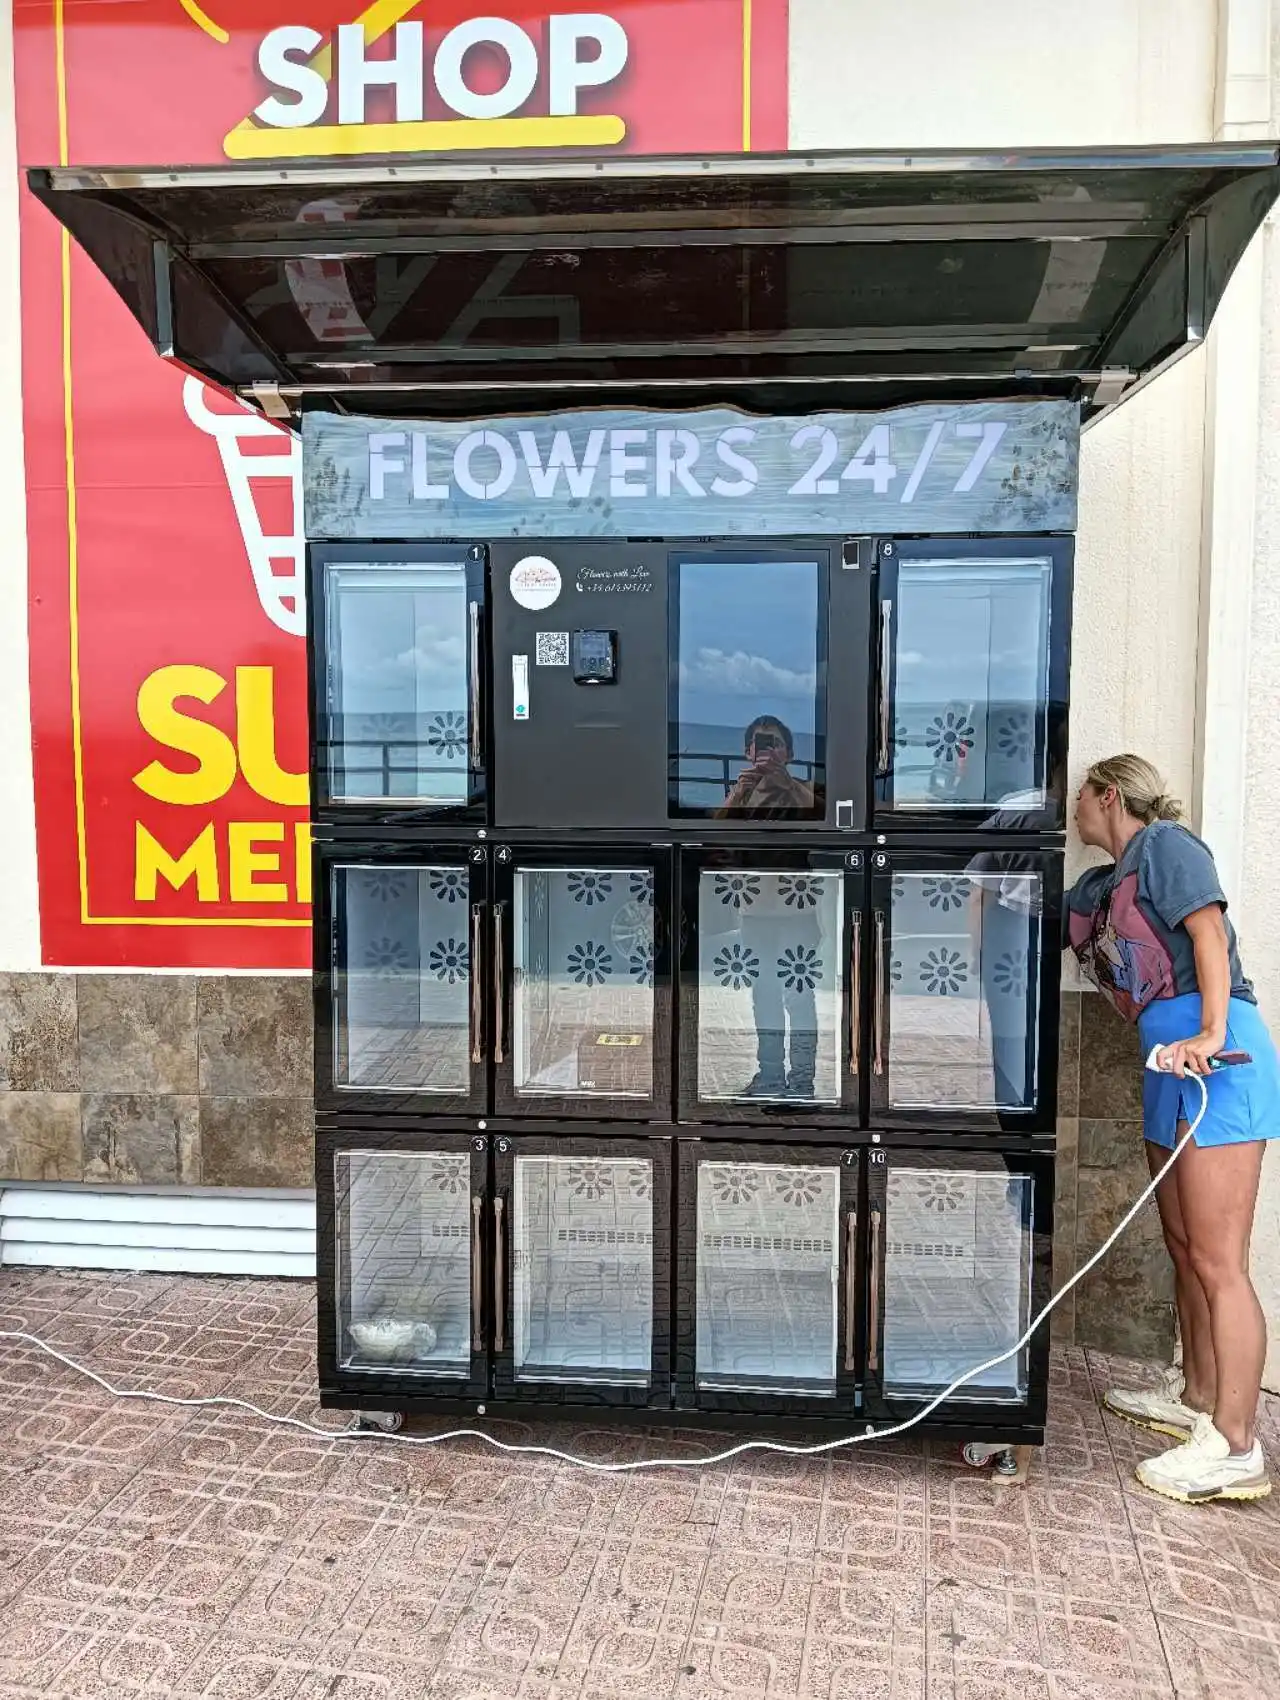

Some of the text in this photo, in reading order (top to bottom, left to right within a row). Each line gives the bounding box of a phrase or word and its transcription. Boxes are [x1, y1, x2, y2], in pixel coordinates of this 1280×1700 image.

[254, 13, 629, 128] SHOP
[368, 421, 1007, 503] FLOWERS 24/7
[472, 547, 479, 561] 1
[884, 543, 892, 556] 8
[473, 849, 482, 861] 2
[498, 849, 507, 861] 4
[850, 854, 859, 866] 6
[876, 854, 886, 867] 9
[475, 1139, 484, 1151] 3
[499, 1140, 507, 1152] 5
[845, 1153, 854, 1165] 7
[870, 1152, 885, 1164] 10
